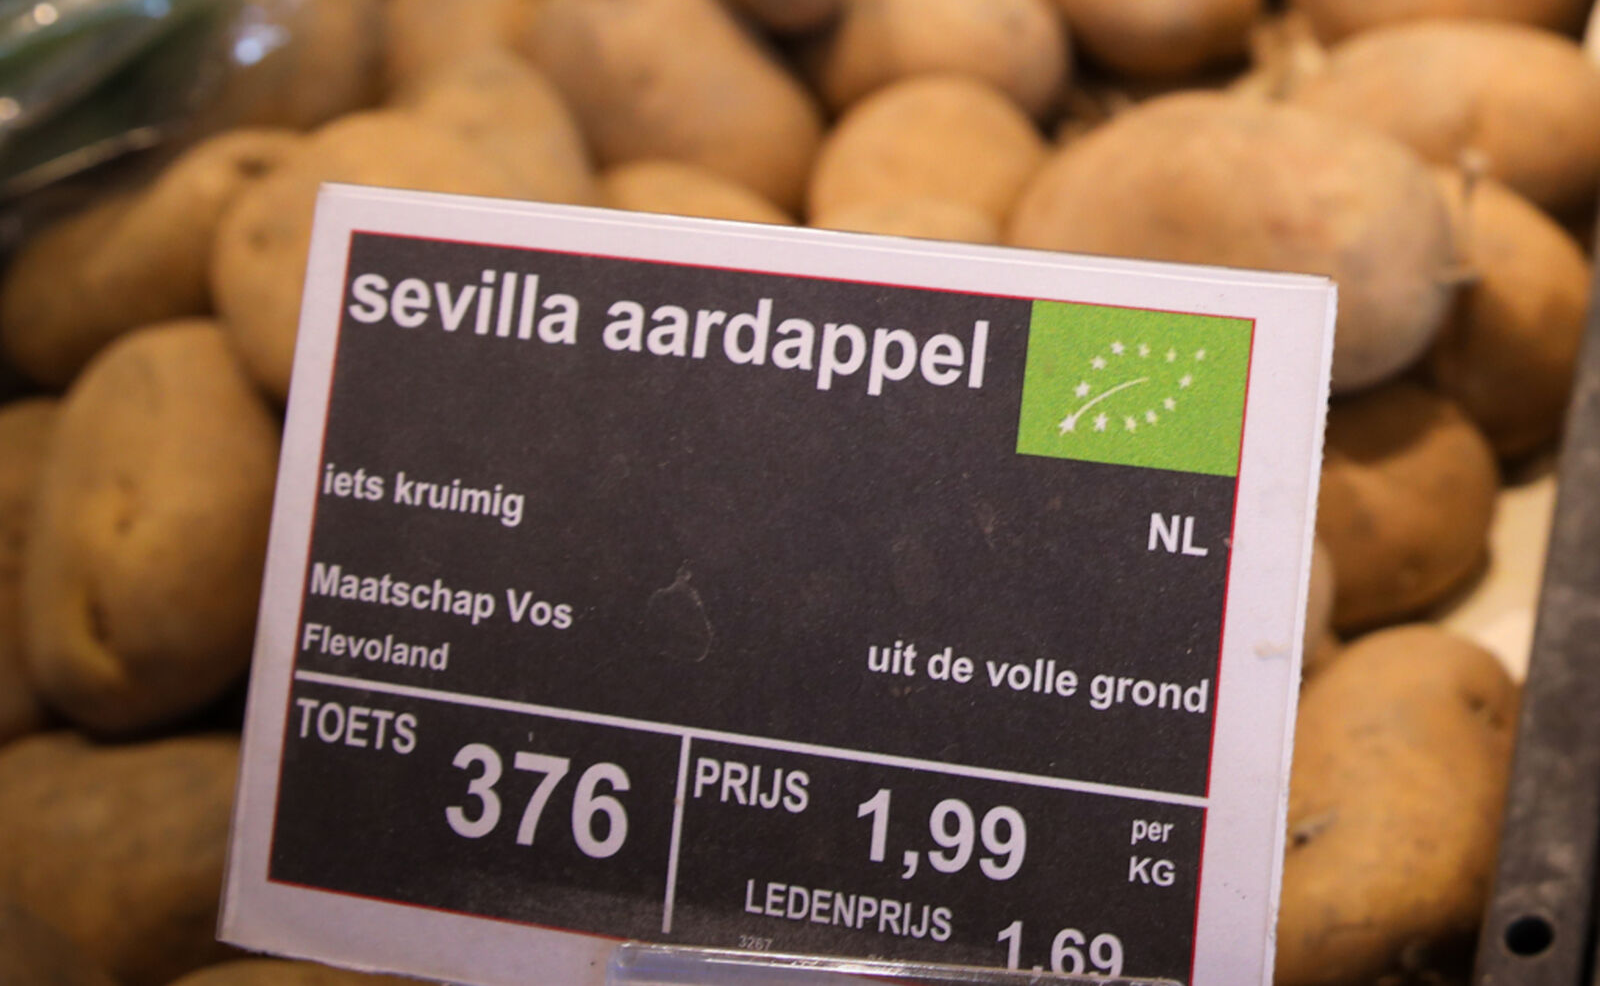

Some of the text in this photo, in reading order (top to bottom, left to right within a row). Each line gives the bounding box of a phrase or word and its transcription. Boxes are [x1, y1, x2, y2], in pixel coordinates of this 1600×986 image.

[348, 268, 991, 398] sevilla aardappel
[322, 462, 526, 528] iets kruimig
[1147, 512, 1210, 557] NL
[310, 562, 574, 630] Maatschap Vos
[302, 622, 450, 672] Flevoland
[867, 640, 1210, 714] uit de volle grond
[296, 697, 419, 755] TOETS
[445, 742, 631, 859] 376
[693, 756, 810, 815] PRIJS
[856, 787, 1028, 881] 1,99
[1130, 818, 1175, 846] per
[1127, 856, 1177, 887] KG
[744, 878, 953, 943] LEDENPRIJS
